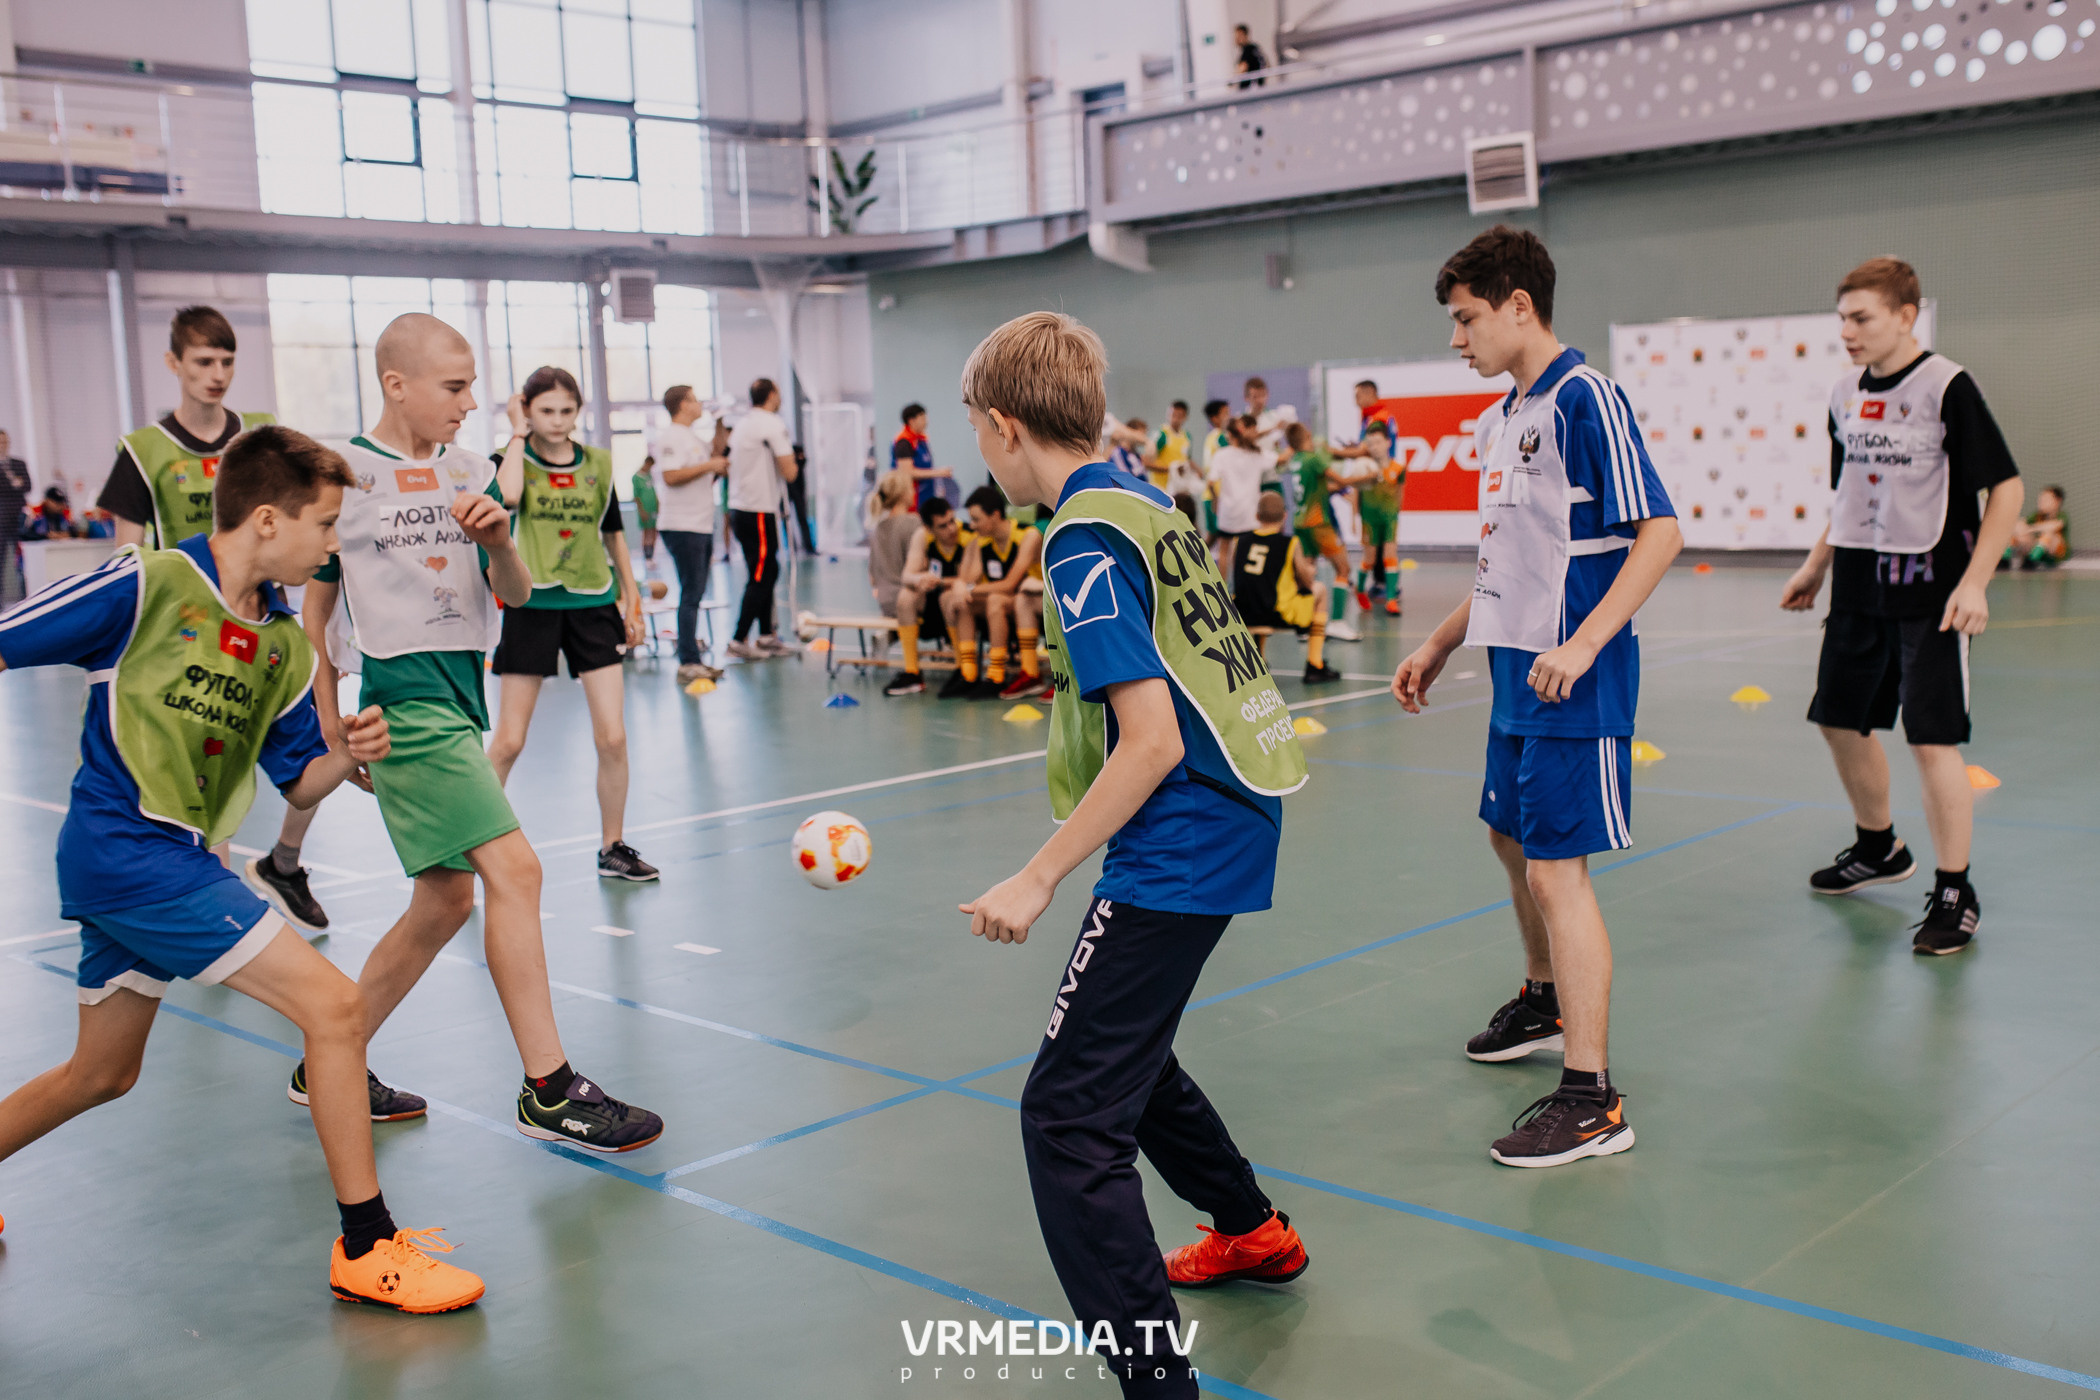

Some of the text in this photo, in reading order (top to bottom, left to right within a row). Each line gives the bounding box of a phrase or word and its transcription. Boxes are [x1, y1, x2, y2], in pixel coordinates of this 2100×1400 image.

[1155, 529, 1211, 588] СПОР
[1244, 543, 1270, 576] 5
[1200, 631, 1270, 695] ЖИ
[1240, 688, 1286, 723] ФЕДЕРА
[1255, 715, 1297, 756] ПРОЕК
